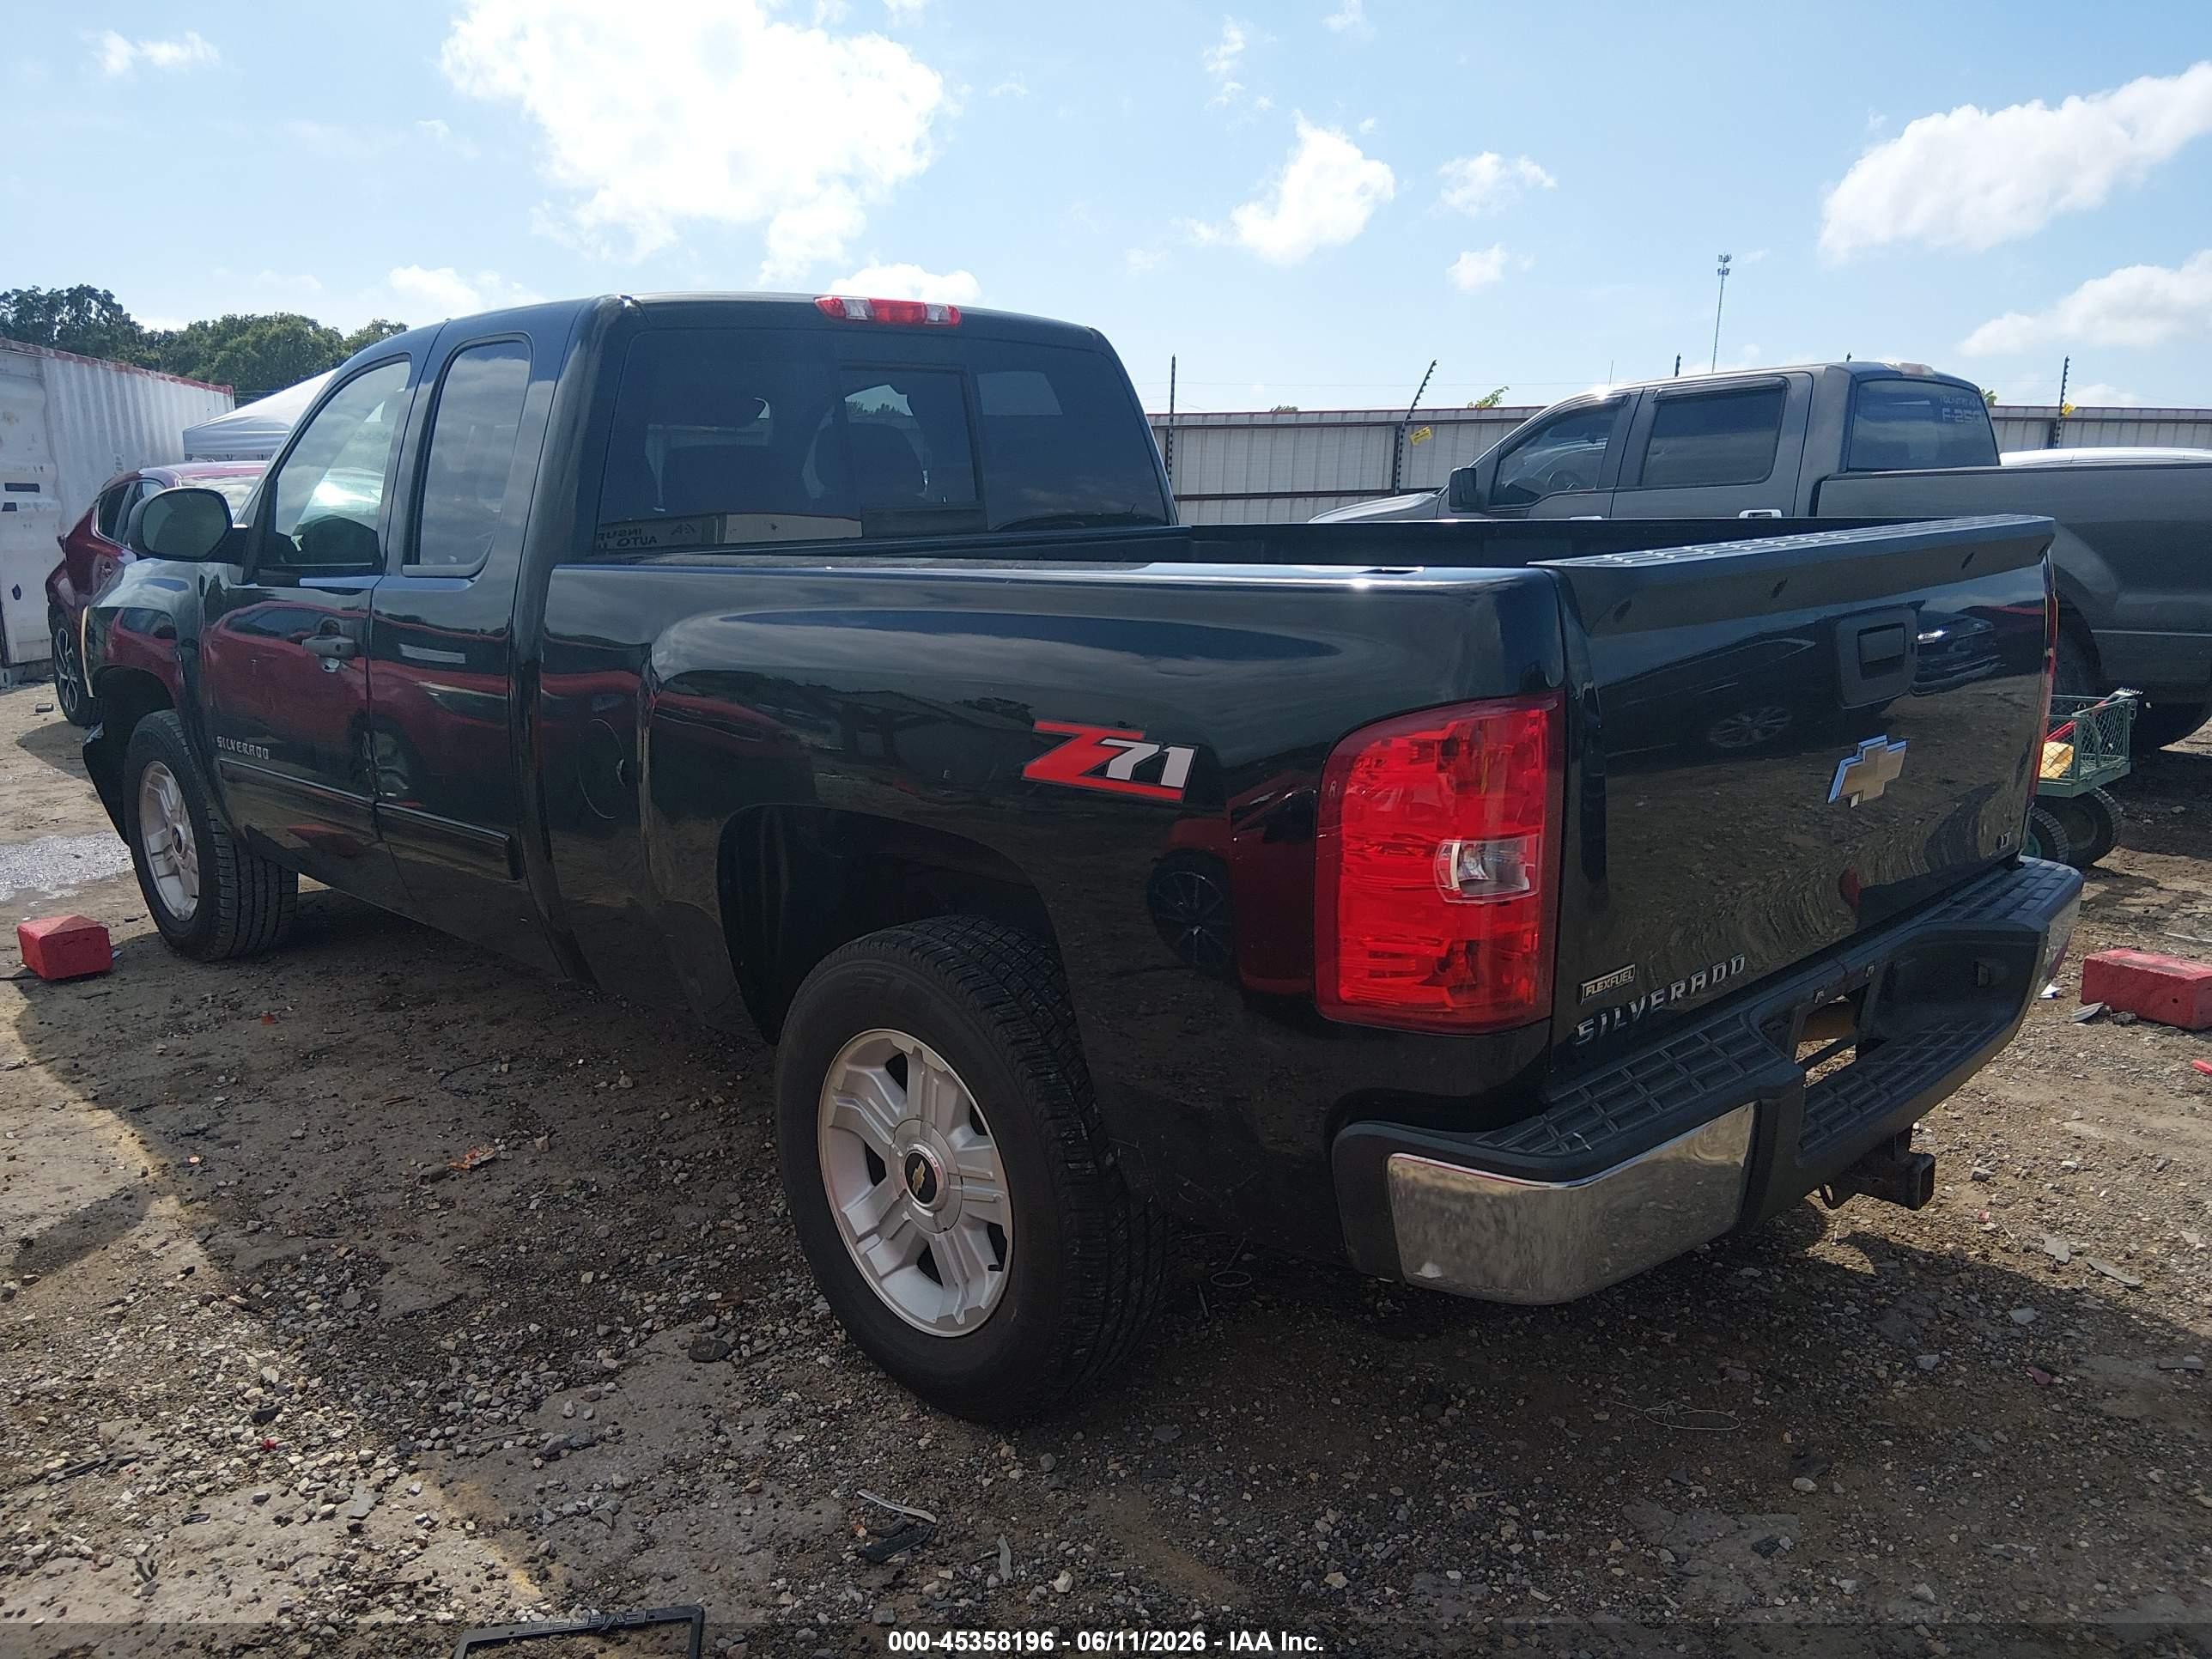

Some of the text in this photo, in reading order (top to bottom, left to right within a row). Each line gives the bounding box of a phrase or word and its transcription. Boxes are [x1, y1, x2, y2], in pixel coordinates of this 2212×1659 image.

[216, 736, 269, 760] SILVERADO
[1022, 720, 1196, 802] Z71
[1574, 954, 1746, 1044] SILVERADO
[1585, 970, 1634, 997] FLEXFUEL
